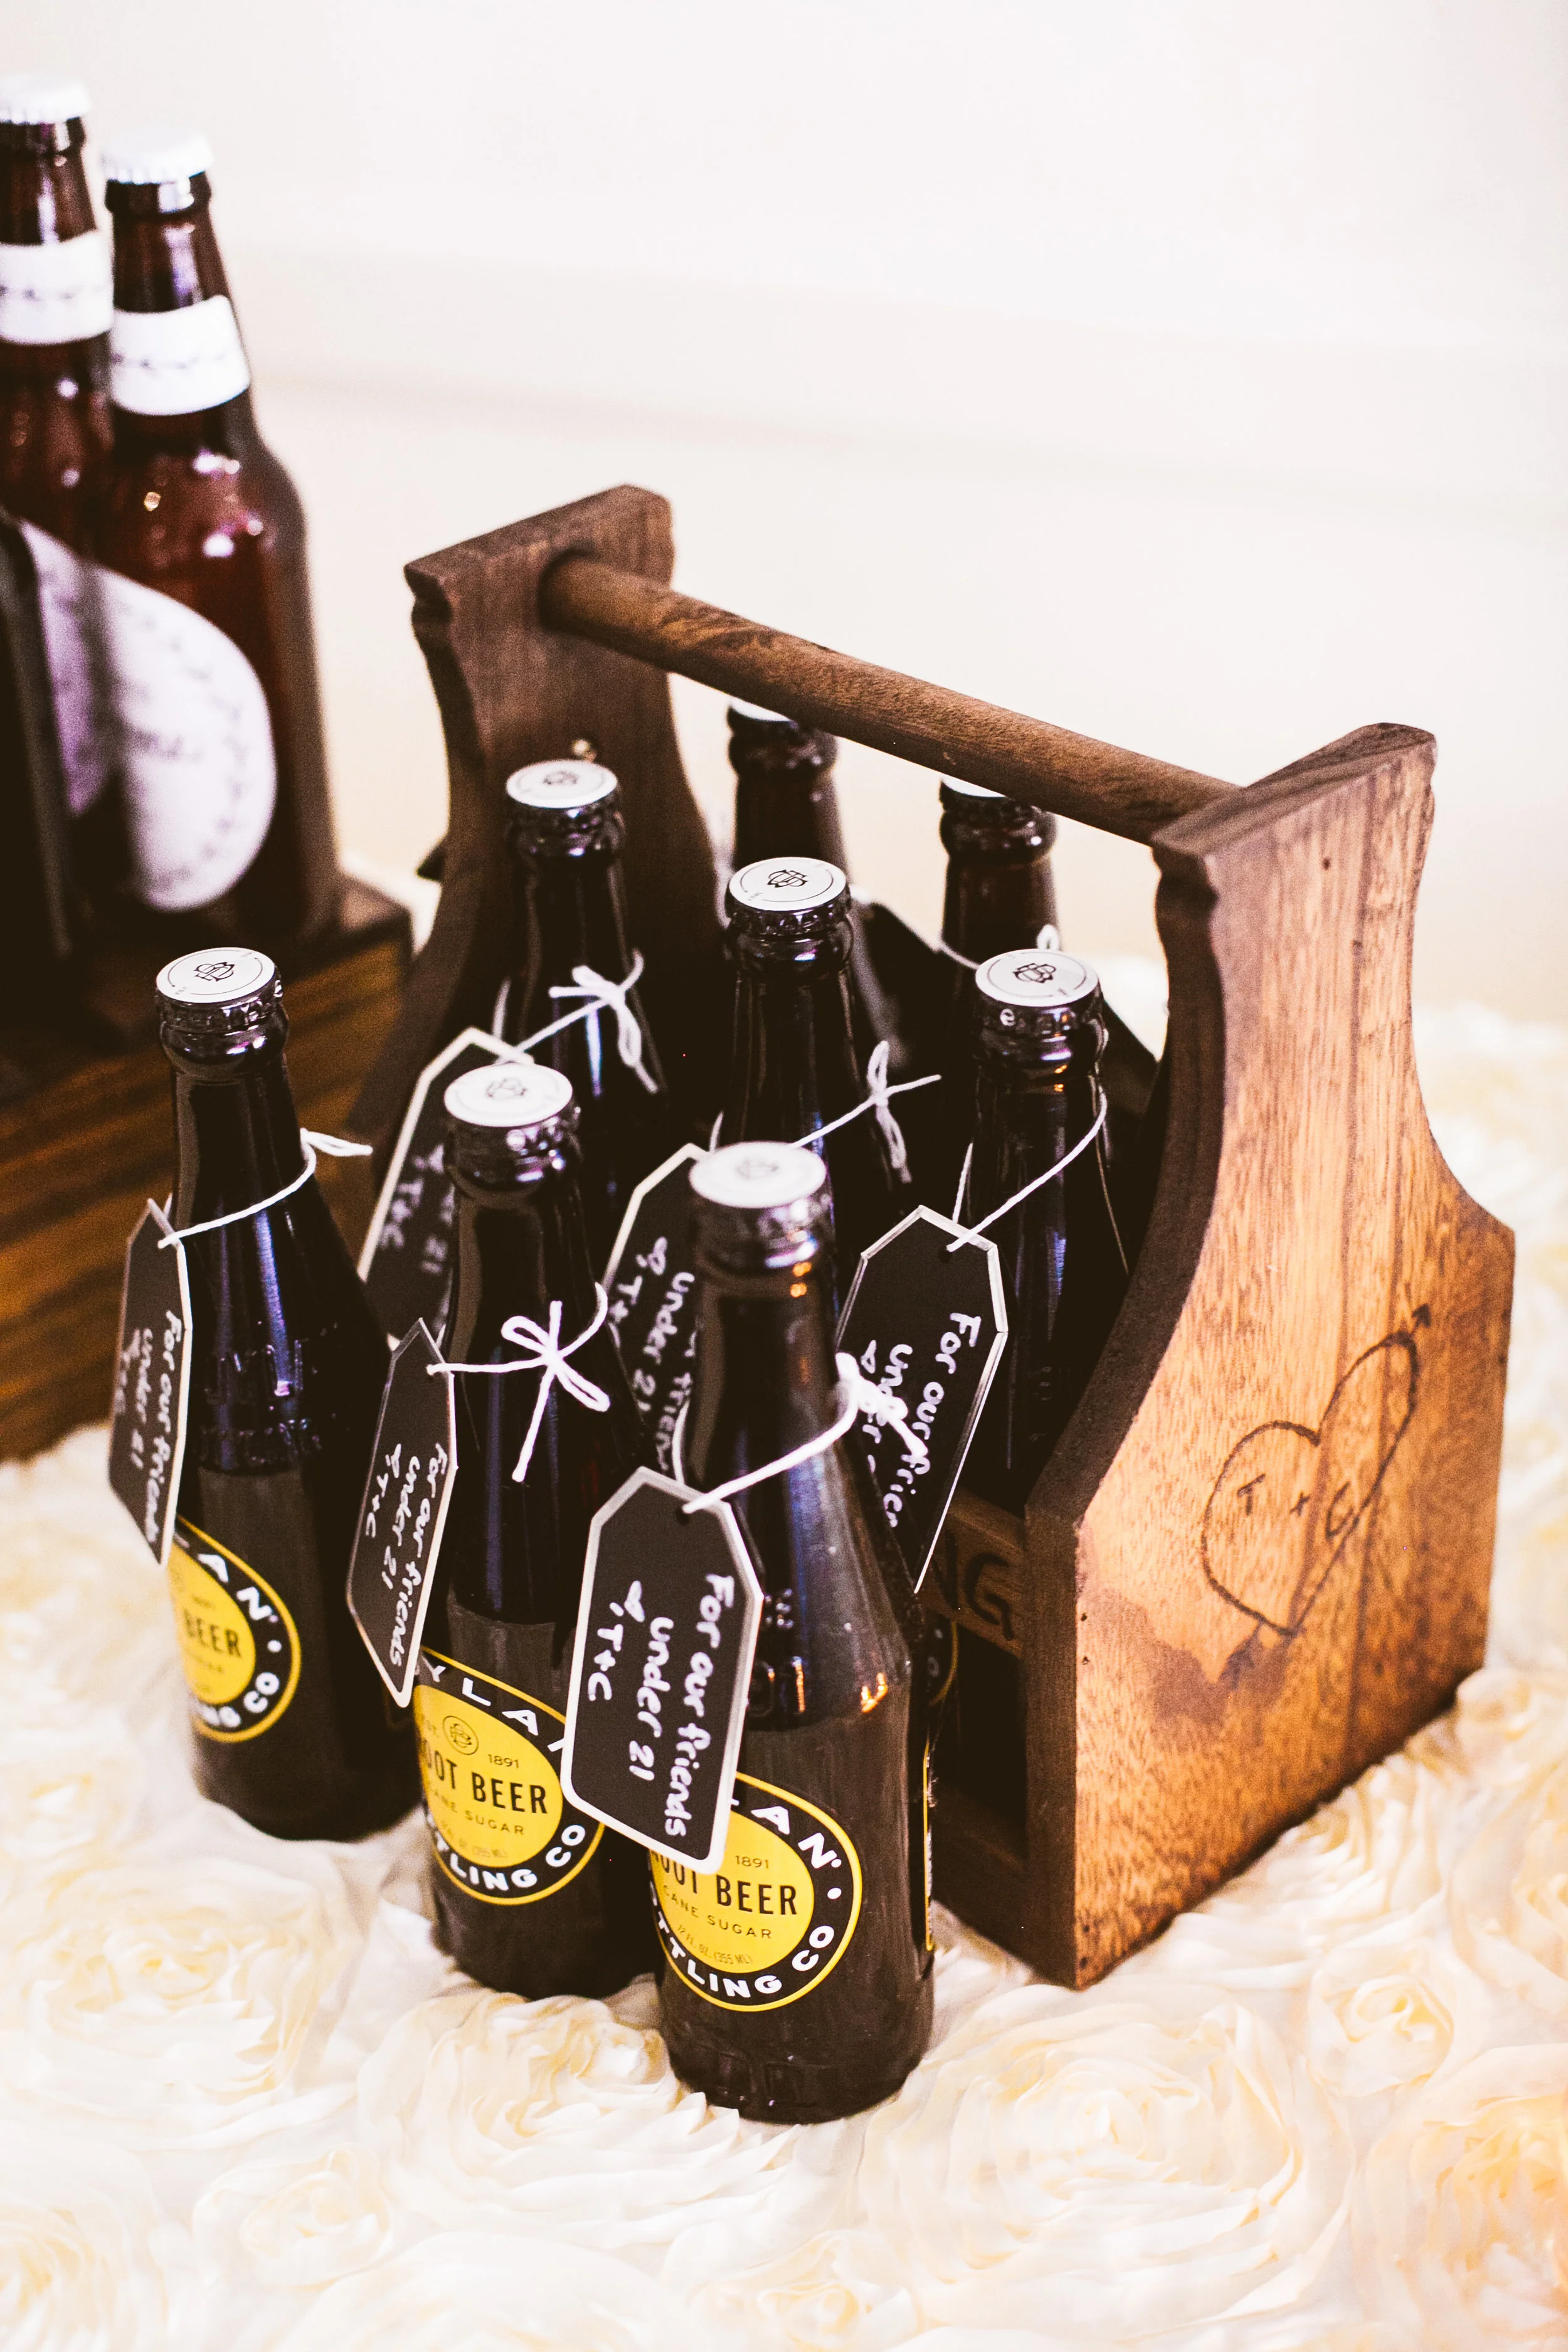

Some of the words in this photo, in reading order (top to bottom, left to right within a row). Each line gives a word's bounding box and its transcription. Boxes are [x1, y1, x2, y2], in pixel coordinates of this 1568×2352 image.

[162, 1309, 183, 1372] For
[642, 1271, 695, 1365] under
[936, 1311, 981, 1375] For
[157, 1372, 174, 1433] our
[911, 1381, 945, 1441] our
[426, 1441, 448, 1499] For
[391, 1455, 421, 1547] under
[413, 1498, 432, 1558] our
[381, 1545, 397, 1590] 21
[389, 1561, 423, 1668] friends
[696, 1572, 734, 1649] For
[243, 1671, 280, 1714] CO
[637, 1616, 674, 1738] under
[684, 1651, 714, 1718] our
[487, 1754, 520, 1769] 1891
[629, 1740, 654, 1781] 21
[664, 1723, 711, 1837] friends
[472, 1771, 548, 1814] BEER
[464, 1809, 526, 1836] SUGAR
[545, 1825, 586, 1868] CO
[734, 1855, 770, 1870] 1891
[662, 1883, 700, 1919] CANE
[707, 1914, 773, 1939] SUGAR
[716, 1874, 798, 1916] BEER
[792, 1926, 835, 1971] CO
